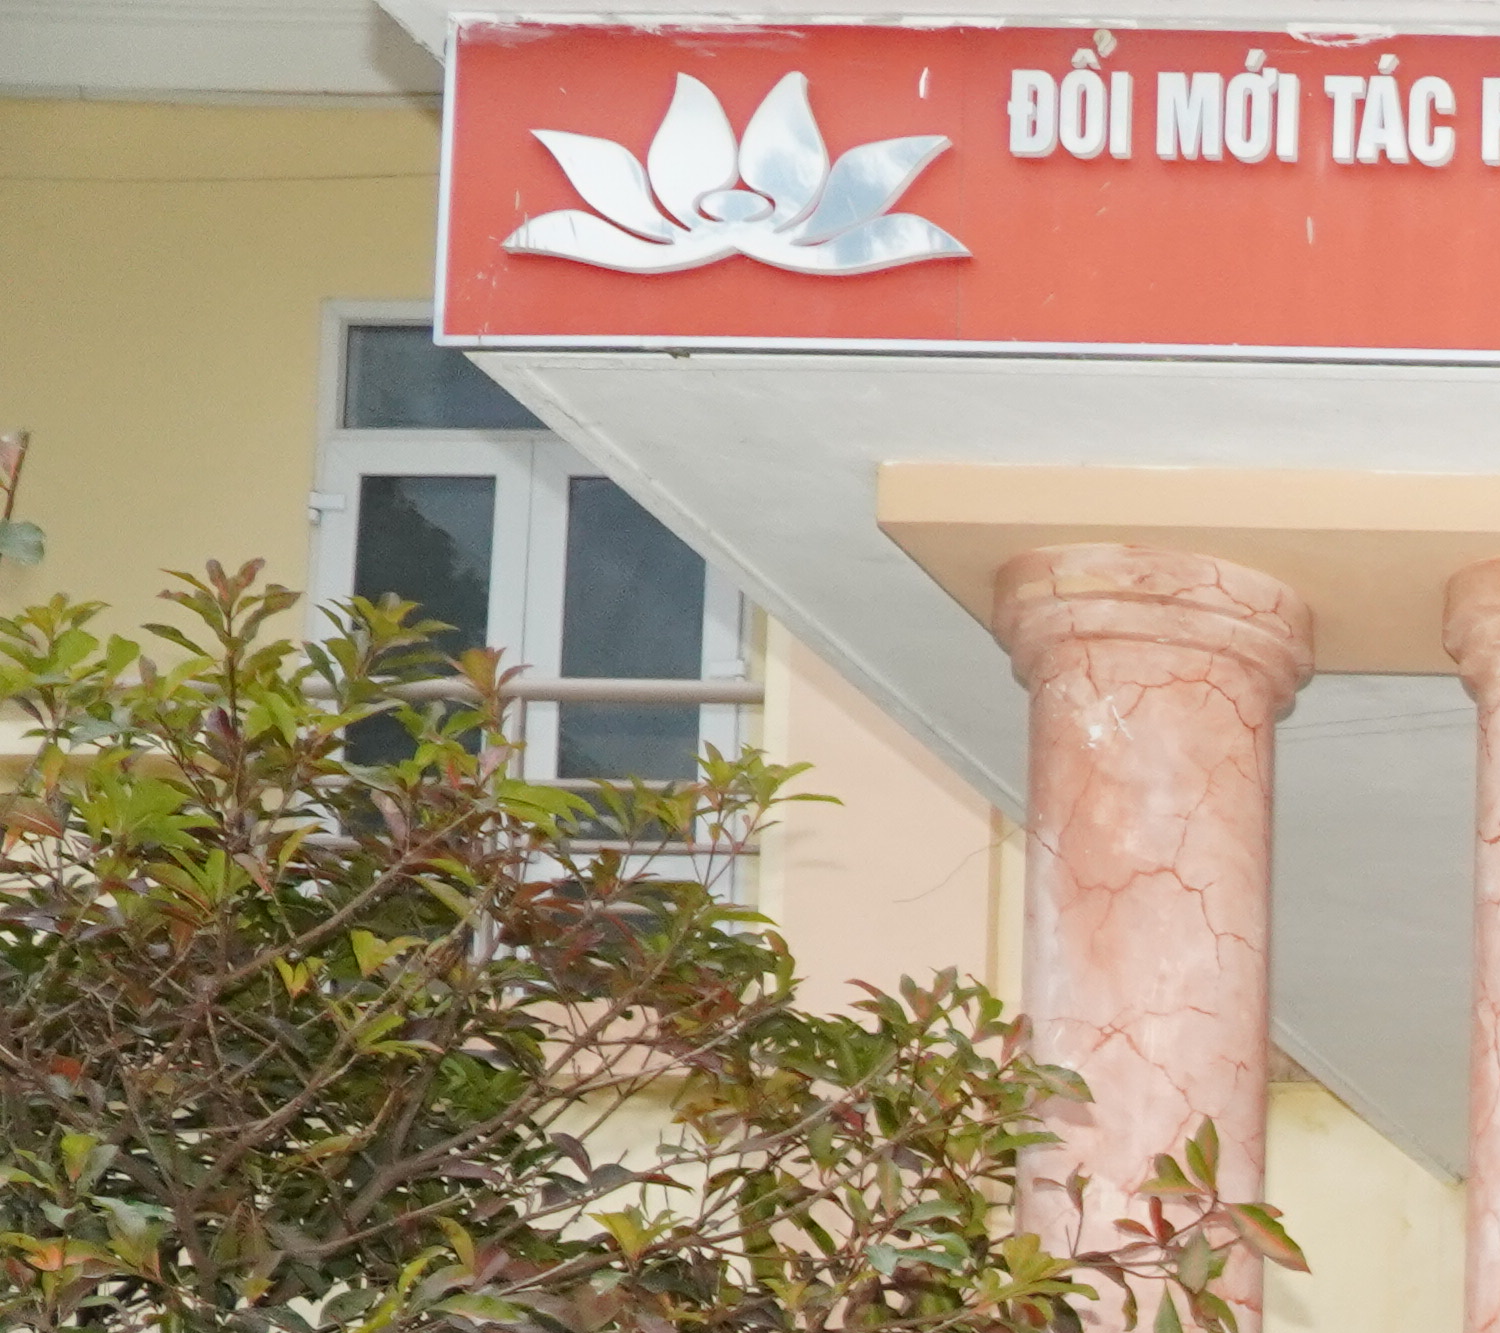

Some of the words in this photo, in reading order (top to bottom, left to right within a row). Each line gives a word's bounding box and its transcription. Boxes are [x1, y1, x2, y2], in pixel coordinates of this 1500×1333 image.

[1007, 29, 1132, 161] ĐỔI
[1155, 48, 1299, 162] MỚI
[1324, 54, 1457, 167] TÁC
